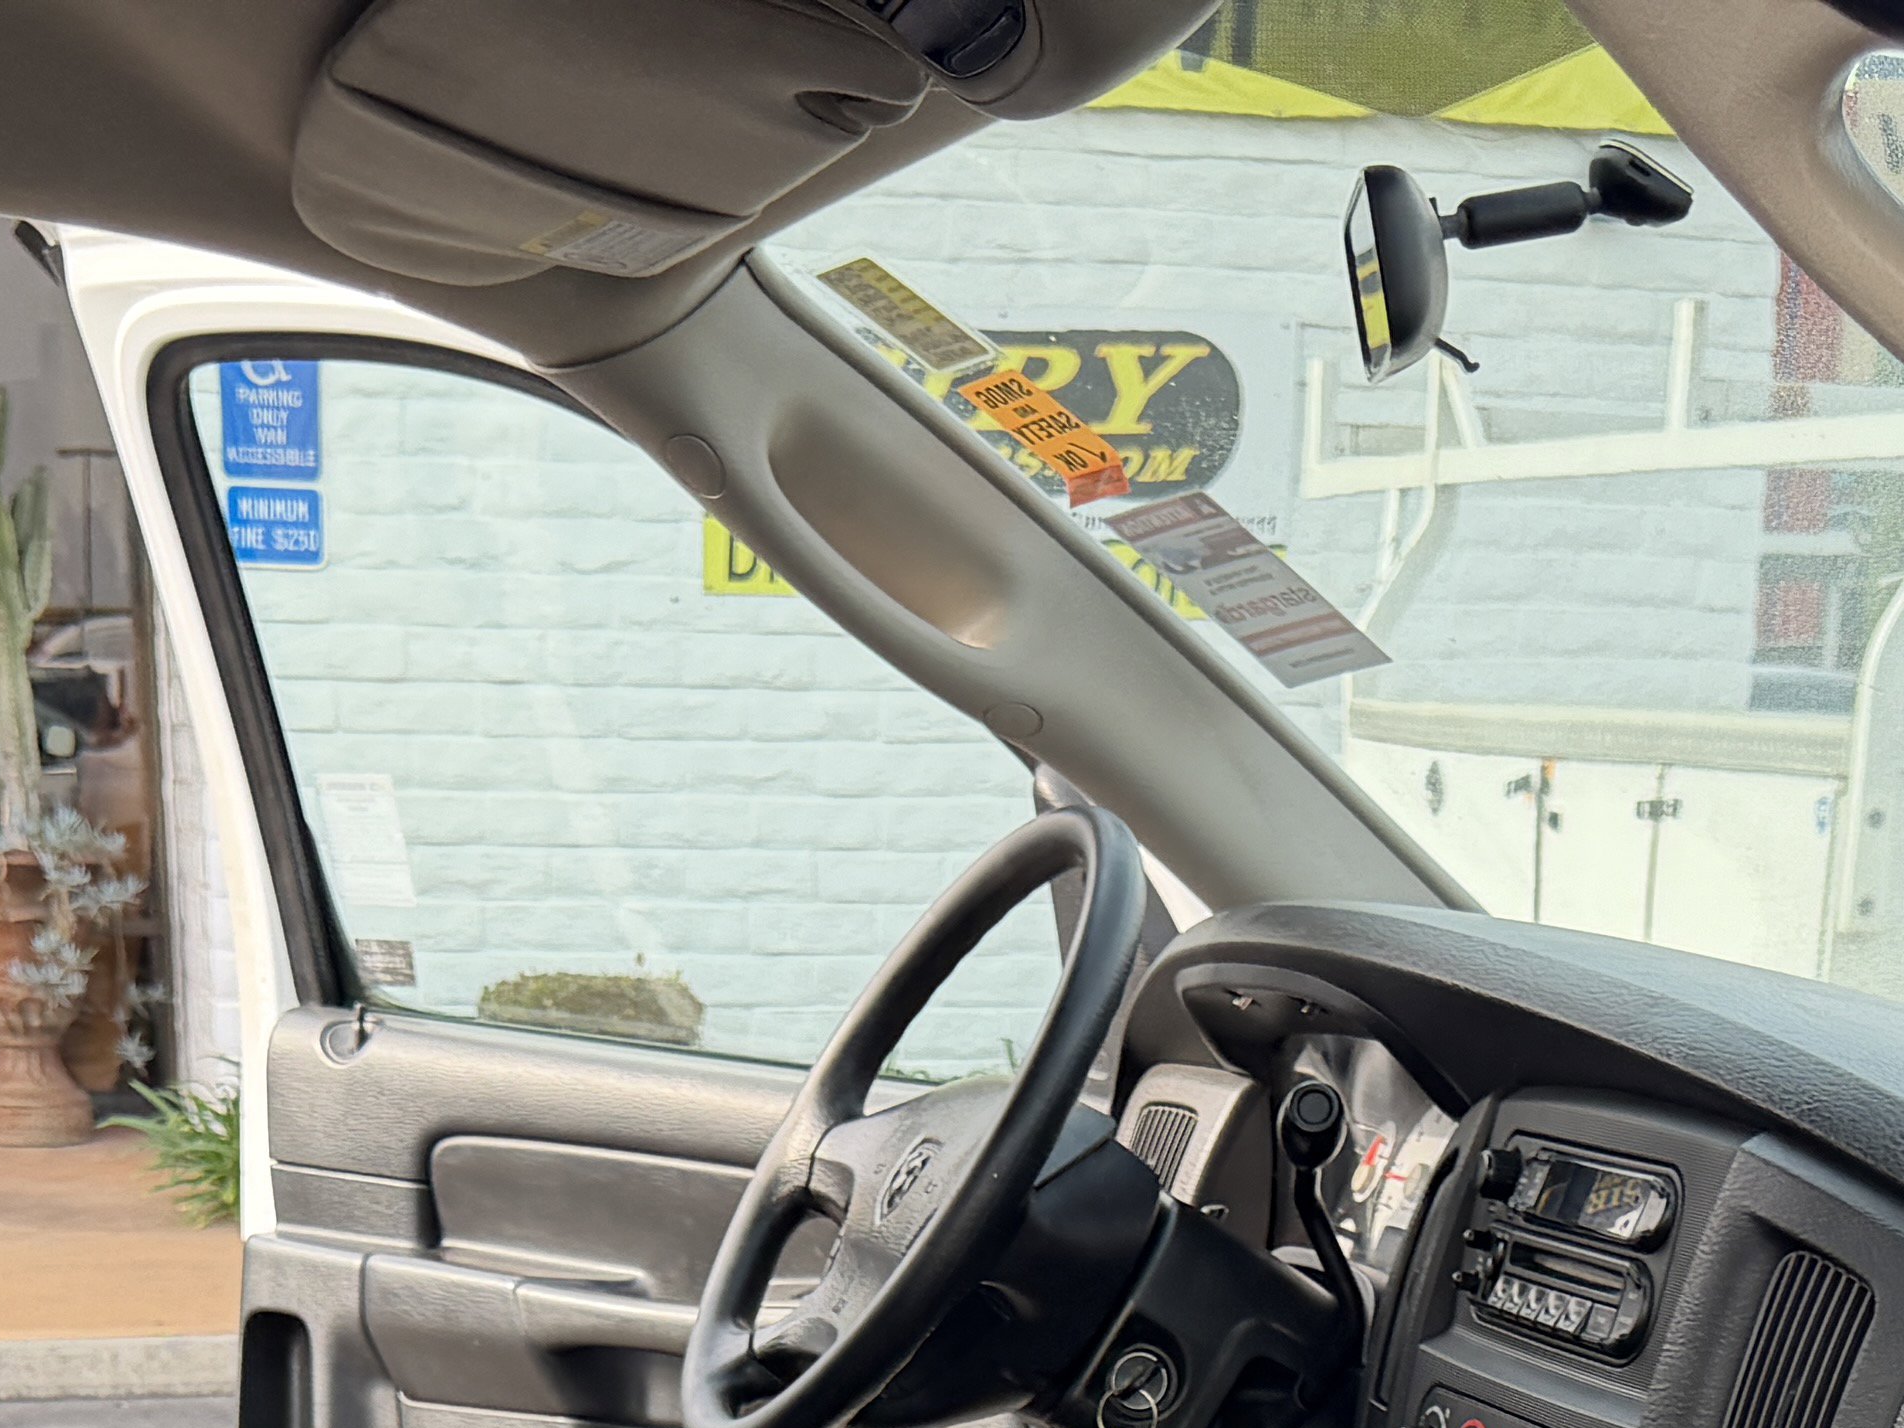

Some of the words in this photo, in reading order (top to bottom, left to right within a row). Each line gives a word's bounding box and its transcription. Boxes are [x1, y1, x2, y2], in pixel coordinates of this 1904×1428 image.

[235, 384, 303, 408] PARKING
[249, 408, 289, 427] ONLY
[253, 428, 287, 445] VAN
[227, 447, 316, 467] ACCESSIBLE
[236, 498, 309, 522] MINIMUM
[231, 526, 266, 550] FINE
[271, 528, 319, 551] $250
